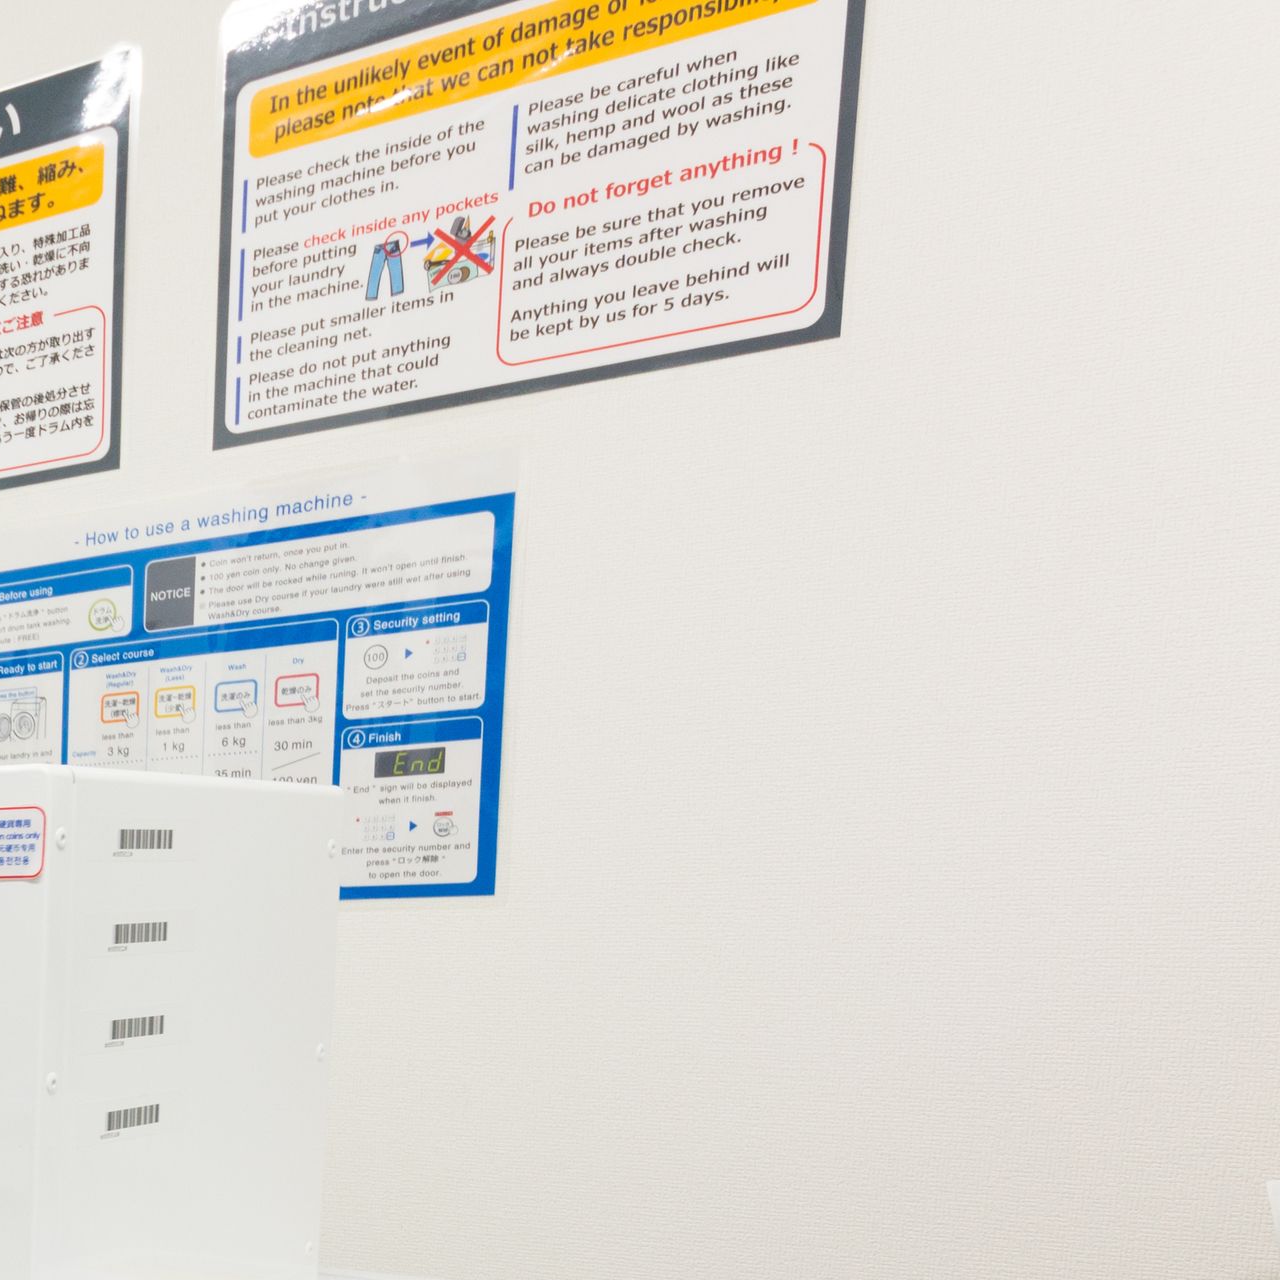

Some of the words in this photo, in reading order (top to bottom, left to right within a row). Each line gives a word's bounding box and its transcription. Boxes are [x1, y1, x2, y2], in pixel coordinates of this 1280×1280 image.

[270, 96, 288, 113] In
[297, 85, 326, 104] the
[334, 58, 410, 94] unlikely
[418, 37, 474, 69] event
[482, 27, 503, 50] of
[510, 4, 598, 42] damage
[528, 92, 583, 115] Please
[590, 85, 610, 99] be
[617, 63, 679, 91] careful
[687, 50, 736, 72] when
[274, 109, 334, 143] please
[441, 71, 469, 91] we
[477, 60, 514, 81] can
[522, 44, 561, 72] not
[567, 29, 614, 62] take
[256, 169, 301, 189] Please
[307, 155, 349, 175] check
[355, 148, 379, 162] the
[385, 134, 431, 154] inside
[437, 125, 452, 140] of
[458, 120, 484, 135] the
[528, 201, 555, 217] Do
[564, 188, 598, 208] not
[605, 170, 672, 199] forget
[680, 146, 781, 181] anything
[510, 298, 587, 322] Anything
[594, 290, 624, 308] you
[632, 279, 678, 297] leave
[686, 261, 749, 286] behind
[757, 253, 789, 271] will
[510, 329, 529, 341] be
[536, 318, 572, 336] kept
[579, 315, 599, 328] by
[606, 310, 625, 322] us
[632, 303, 657, 317] for
[664, 297, 673, 310] 5
[681, 290, 728, 307] days.
[86, 531, 118, 545] How
[125, 527, 138, 539] to
[146, 522, 173, 536] use
[181, 519, 189, 530] a
[197, 507, 267, 527] washing
[276, 494, 352, 516] machine
[30, 584, 54, 596] using
[150, 587, 190, 601] NOTICE
[372, 614, 418, 631] Security
[422, 609, 462, 624] setting
[27, 663, 35, 671] to
[38, 660, 56, 669] start
[91, 652, 119, 664] Select
[120, 648, 155, 659] course
[368, 731, 400, 742] Finish
